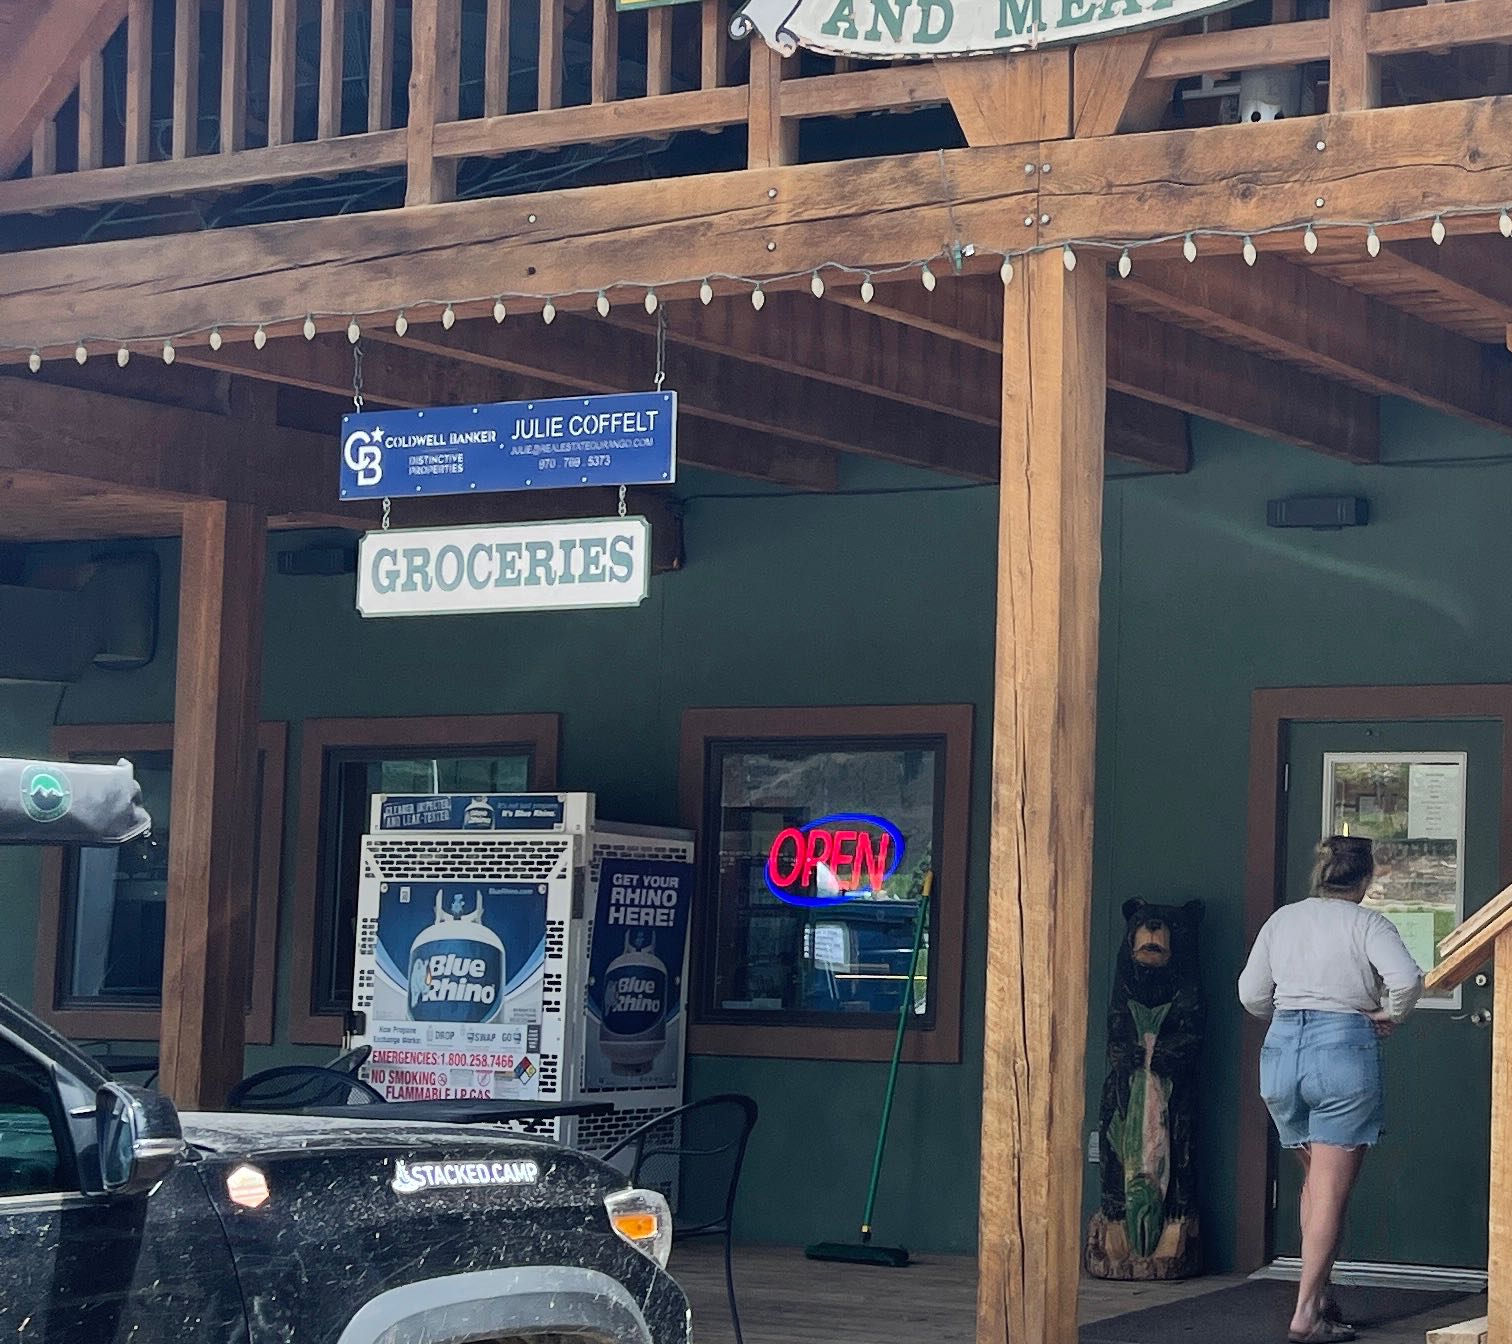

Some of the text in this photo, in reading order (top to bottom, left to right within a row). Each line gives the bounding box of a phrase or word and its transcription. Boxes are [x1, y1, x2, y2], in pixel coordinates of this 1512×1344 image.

[511, 410, 659, 440] JULIE COFFELT
[384, 430, 497, 449] COLDWELL BANKER
[408, 453, 464, 466] DISTINCTIVE
[408, 463, 464, 476] PROPERTIES
[371, 534, 635, 595] GROCERIES
[768, 827, 891, 892] OPEN
[612, 873, 680, 889] GET YOUR
[610, 887, 678, 907] RHINO
[608, 906, 676, 928] HERE!
[429, 953, 486, 978] Blue
[421, 977, 495, 1004] Rhino
[617, 975, 656, 994] Blue
[612, 993, 661, 1014] Rhino
[435, 1030, 455, 1040] DROP
[474, 1032, 496, 1042] SWAP
[501, 1032, 512, 1042] GO
[371, 1069, 386, 1085] NO
[388, 1069, 436, 1086] SMOKING
[411, 1162, 538, 1187] STACKED.CAMP
